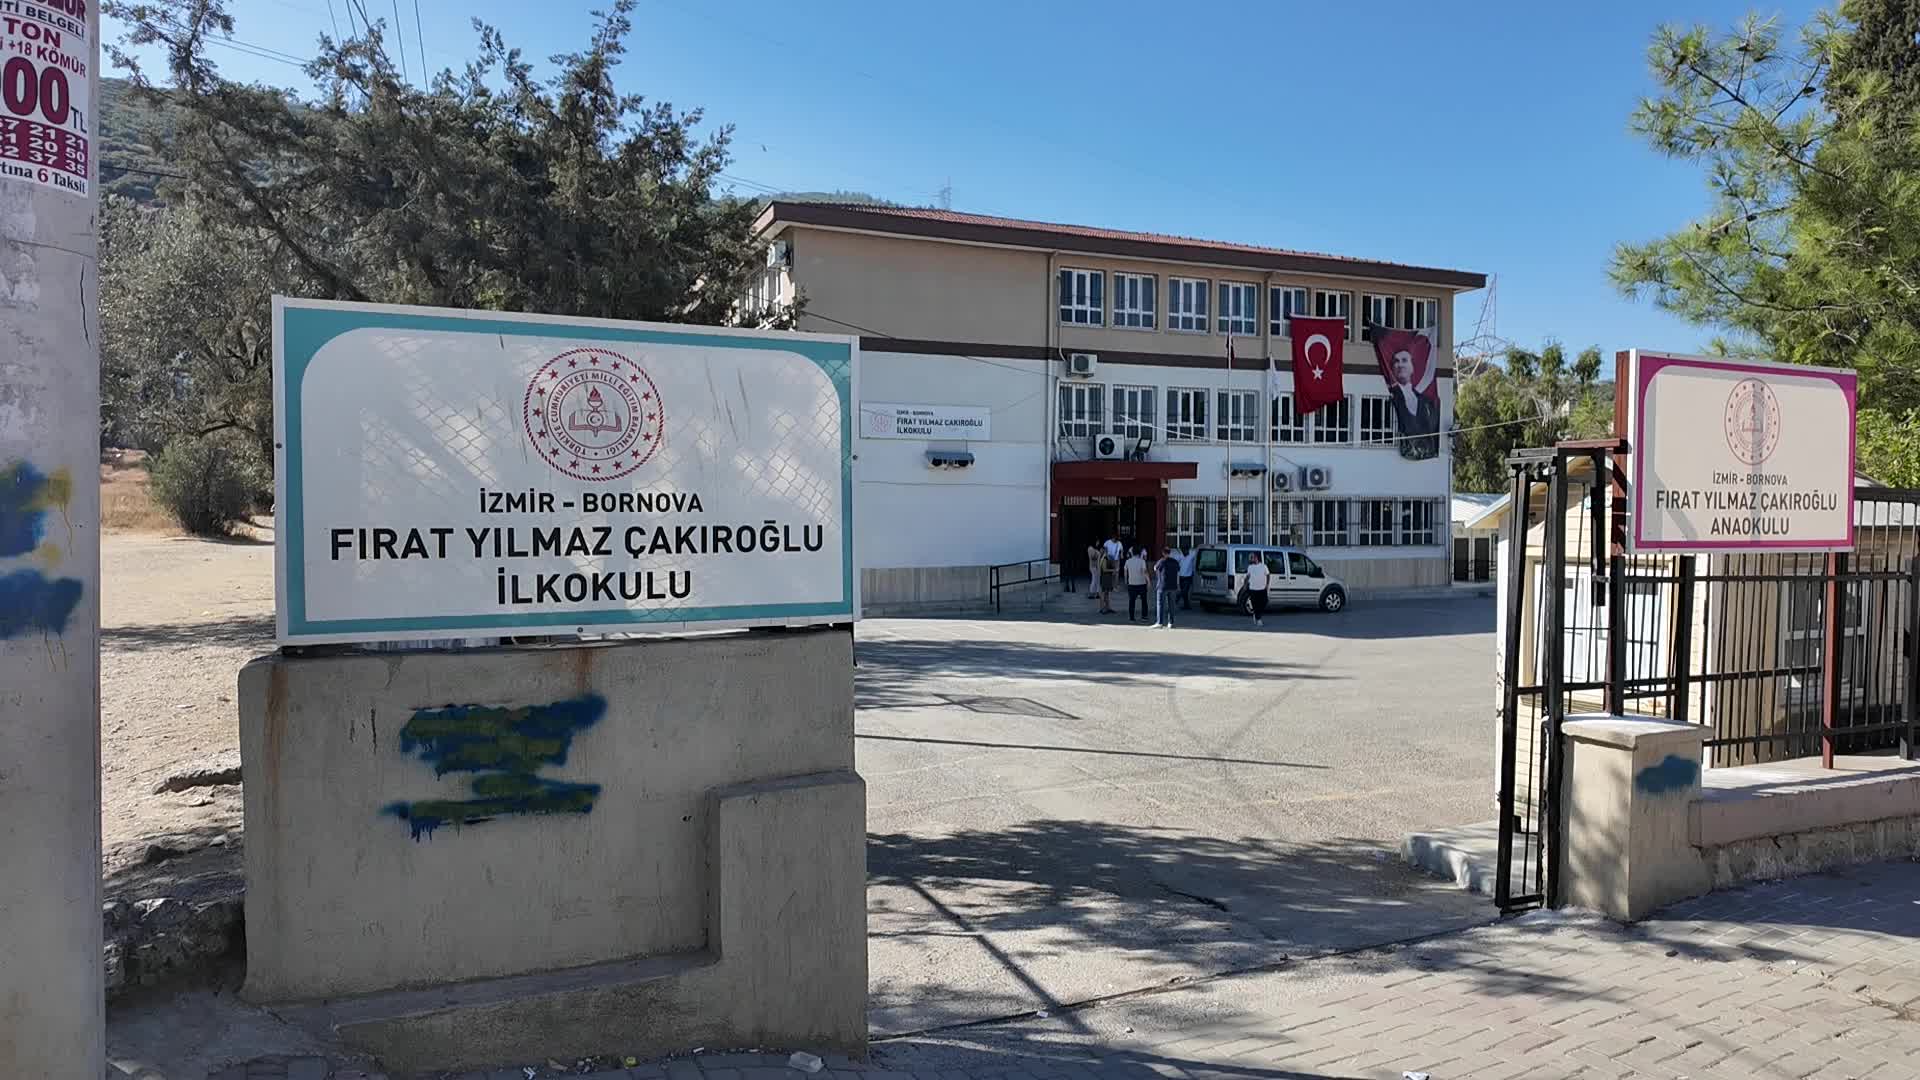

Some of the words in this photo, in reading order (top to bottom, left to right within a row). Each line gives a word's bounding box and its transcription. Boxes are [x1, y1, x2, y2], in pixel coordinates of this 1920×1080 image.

[0, 0, 19, 13] Tİ
[26, 6, 84, 39] BELGELİ
[3, 17, 60, 48] TON
[9, 41, 32, 56] +18
[37, 45, 86, 78] KÖMÜR
[71, 105, 87, 134] TL
[29, 124, 56, 140] 21
[65, 134, 84, 150] 21
[29, 137, 58, 153] 20
[65, 147, 85, 163] 50
[28, 150, 58, 165] 37
[65, 160, 85, 175] 35
[0, 161, 32, 178] tına
[37, 168, 48, 183] 6
[52, 172, 86, 194] Taksit
[1712, 469, 1738, 485] İZMİR
[1746, 473, 1788, 486] BORNOVA
[480, 487, 555, 513] İZMİR
[582, 492, 704, 513] BORNOVA
[1655, 489, 1701, 510] FIRAT
[1704, 491, 1757, 511] YILMAZ
[1760, 489, 1837, 513] ÇAKIROĞLU
[1710, 516, 1790, 536] ANAOKULU
[331, 527, 454, 561] FIRAT
[465, 526, 613, 558] YILMAZ
[624, 519, 823, 559] ÇAKIROĞLU
[497, 566, 691, 605] İLKOKULU
